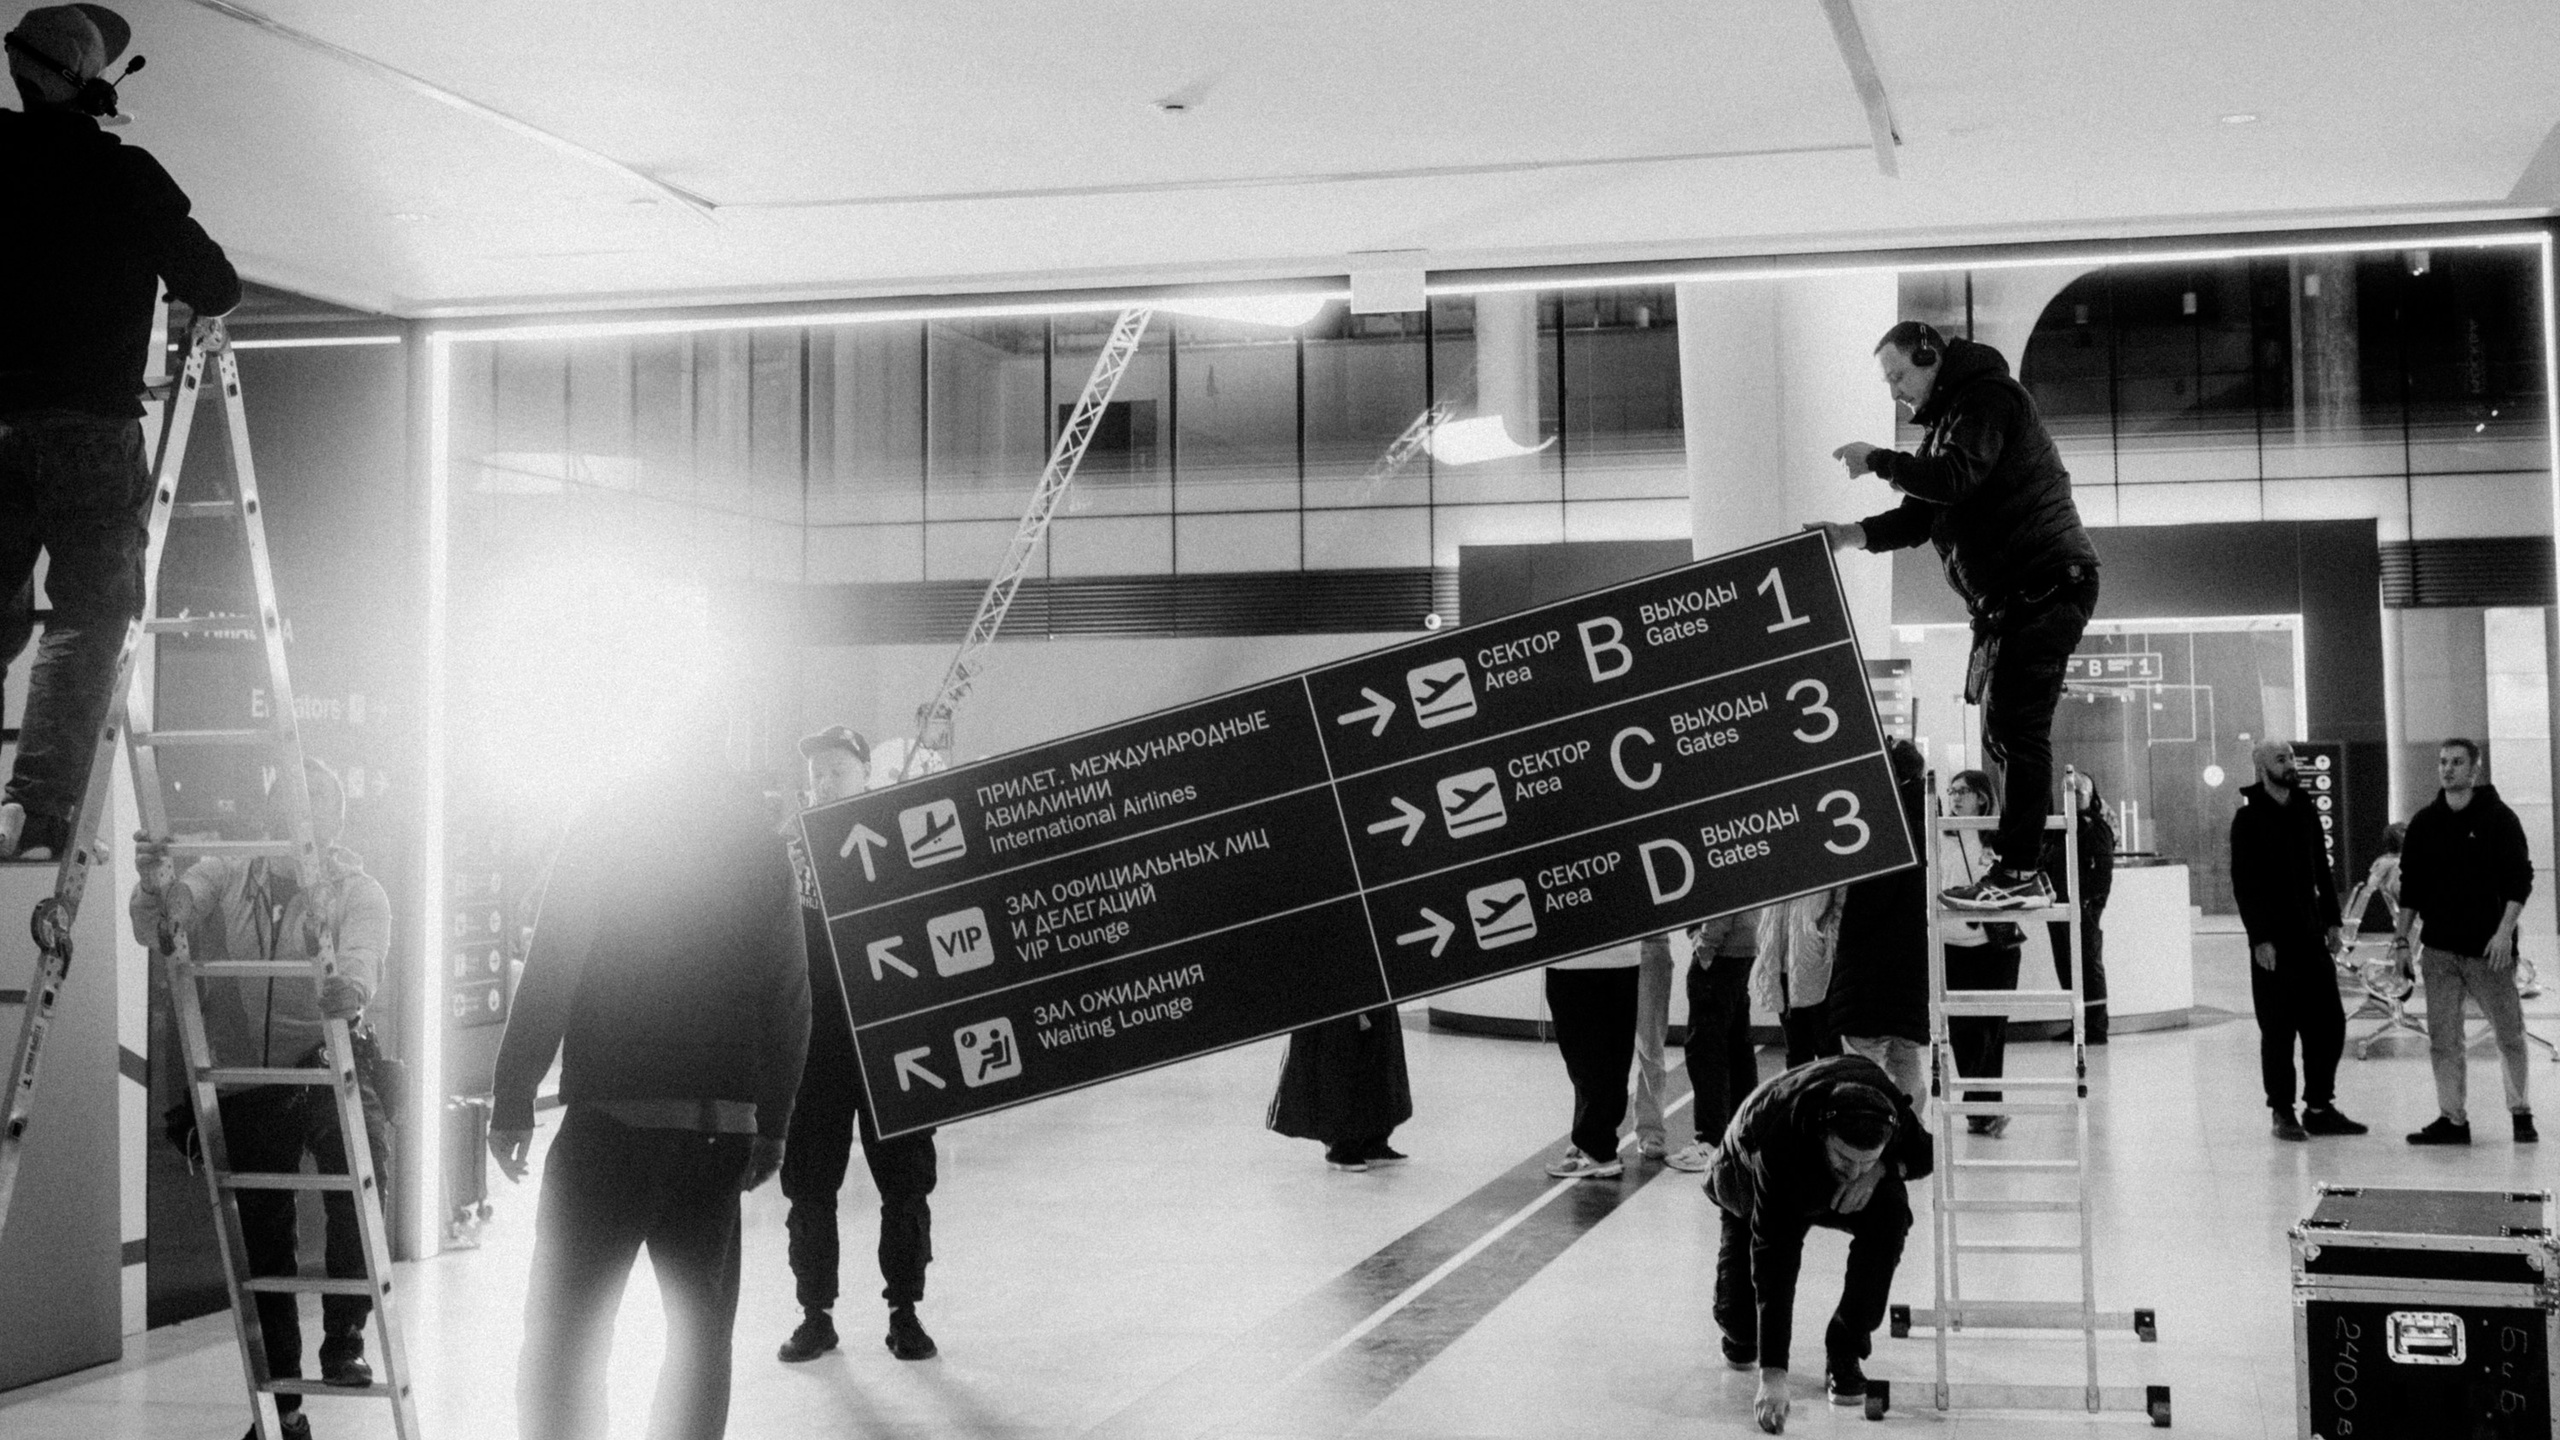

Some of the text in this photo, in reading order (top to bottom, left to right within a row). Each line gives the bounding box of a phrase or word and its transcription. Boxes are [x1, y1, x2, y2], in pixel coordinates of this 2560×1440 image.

[1639, 581, 1738, 625] ВЫХОДЫ
[1757, 567, 1811, 634] 1
[1477, 630, 1561, 669] СЕКТОР
[1577, 616, 1633, 683] B
[1646, 617, 1709, 646] Gates
[1485, 666, 1533, 692] Area
[2139, 657, 2152, 675] 1
[1669, 691, 1769, 735] ВЫХОДЫ
[1785, 678, 1839, 744] 3
[1069, 710, 1270, 781] МЕЖДУНАРОДНЫЕ
[1507, 740, 1591, 779] СЕКТОР
[1609, 726, 1662, 791] C
[1676, 727, 1740, 756] Gates
[985, 778, 1113, 831] АВИАЛИНИИ
[1515, 776, 1563, 802] Area
[988, 785, 1198, 854] International Airlines
[1700, 803, 1800, 847] ВЫХОДЫ
[1816, 789, 1871, 855] 3
[1005, 828, 1270, 916] ЗАЛ ОФИЦИАЛЬНЫХ ЛИЦ
[1537, 851, 1621, 890] СЕКТОР
[1638, 838, 1695, 905] D
[1707, 840, 1771, 869] Gates
[1011, 881, 1157, 940] И ДЕЛЕГАЦИЙ
[1545, 887, 1593, 913] Area
[936, 926, 982, 958] VIP
[1015, 920, 1130, 962] VIP Lounge
[1033, 963, 1205, 1026] ЗАЛ ОЖИДАНИЯ
[1037, 996, 1193, 1049] Waiting Lounge
